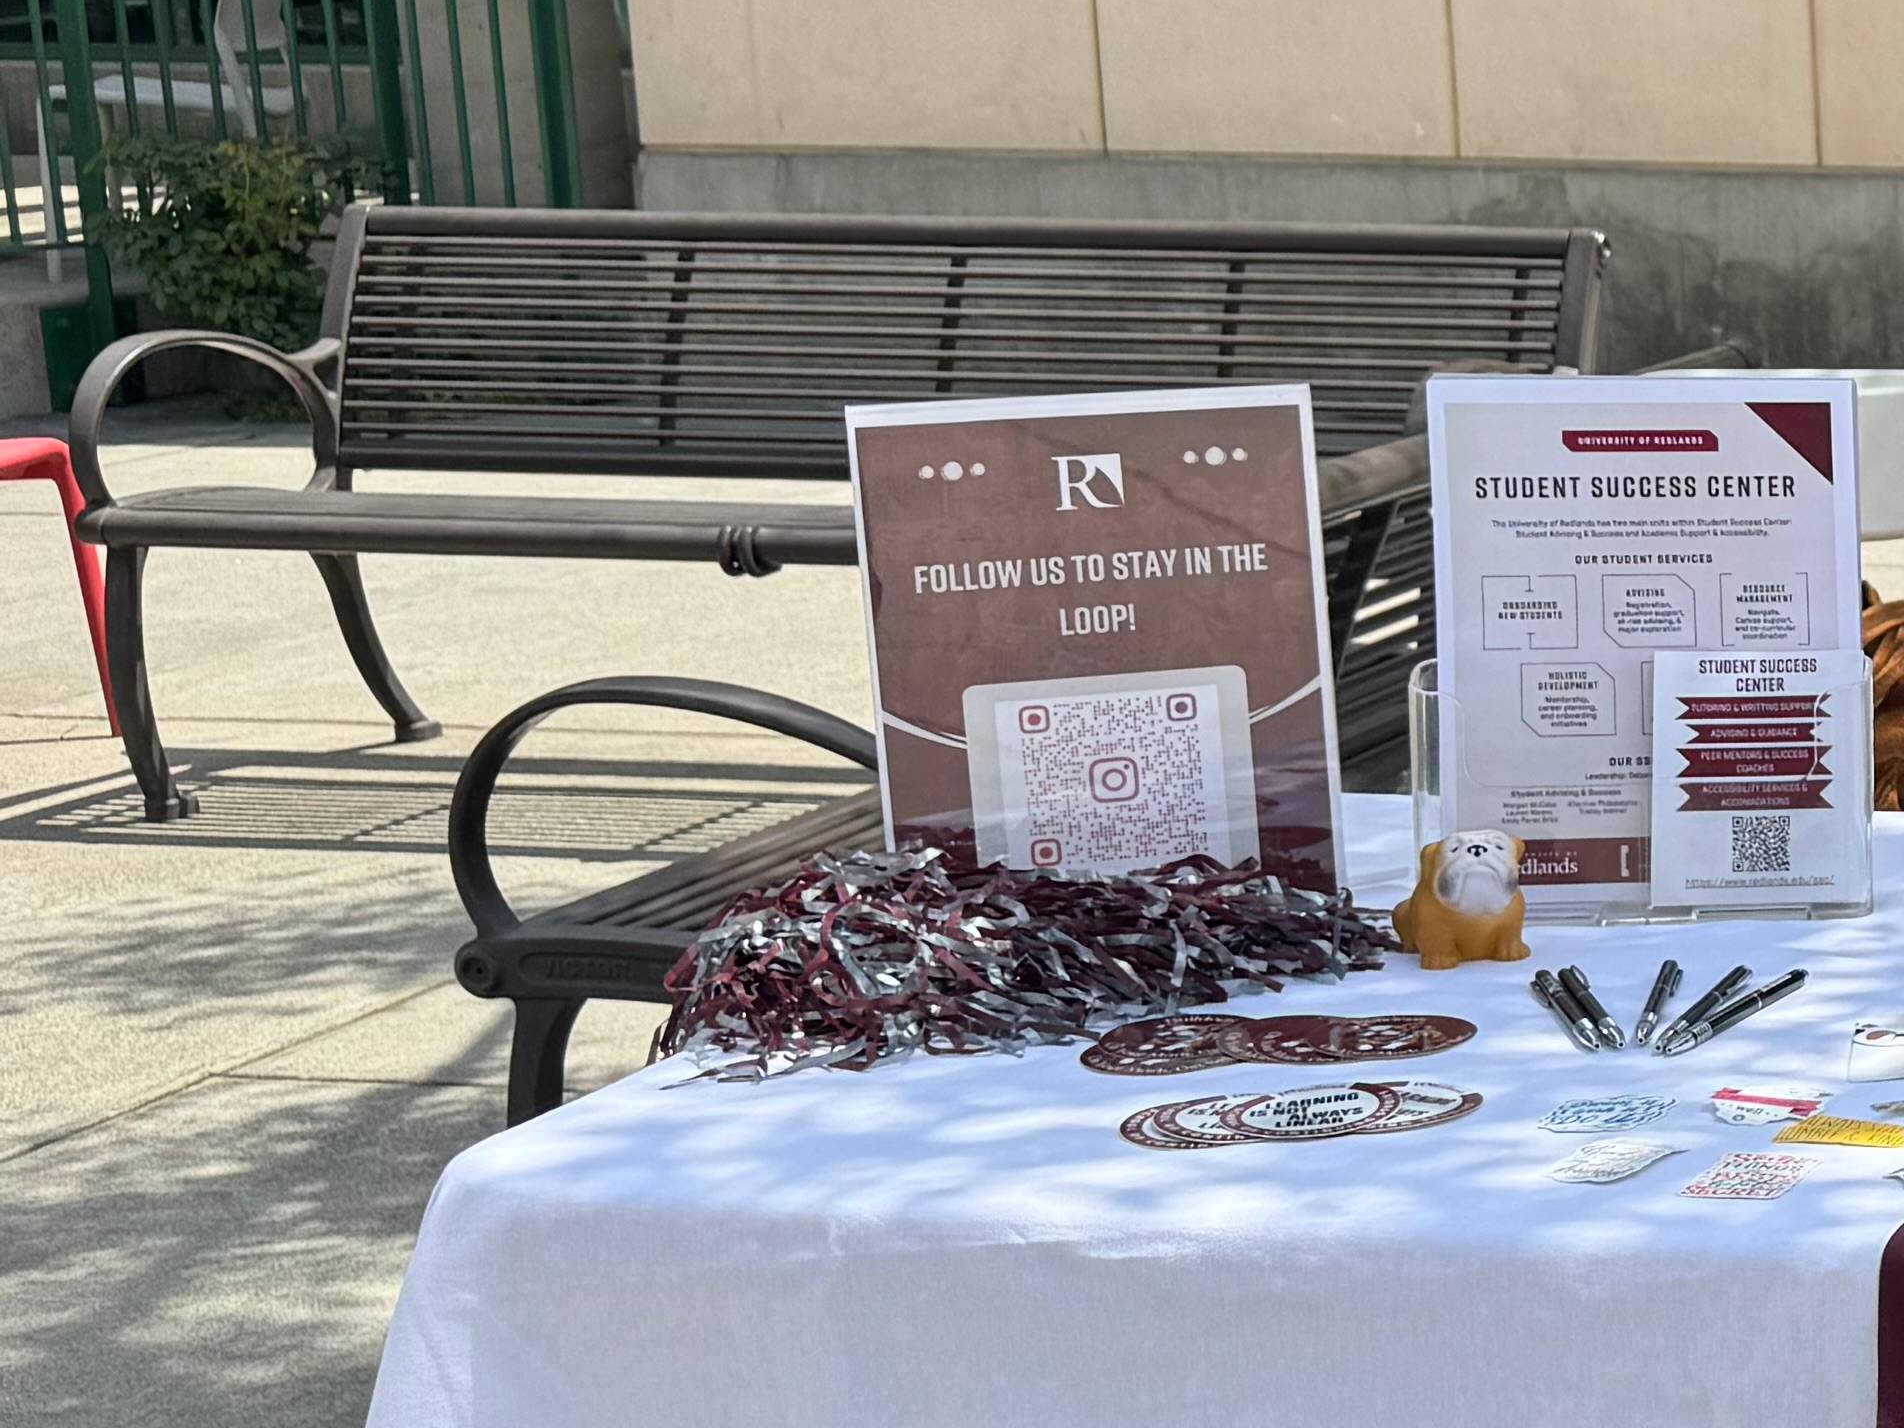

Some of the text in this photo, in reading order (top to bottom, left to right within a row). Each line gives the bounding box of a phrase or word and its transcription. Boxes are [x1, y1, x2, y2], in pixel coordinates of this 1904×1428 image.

[1578, 436, 1703, 445] UNIVERSITY OF REDLANDS
[1475, 475, 1796, 499] STUDENT SUCCESS CENTER
[1575, 554, 1713, 564] OUR STUDENT SERVICES
[914, 543, 1268, 594] FOLLOW US TO STAY IN THE
[1059, 603, 1136, 636] LOOP!
[1519, 611, 1562, 619] STUDENTS
[1699, 658, 1817, 674] STUDENT SUCCESS
[1736, 677, 1785, 692] CENTER
[1609, 757, 1633, 766] OUR
[1265, 1092, 1360, 1110] LEARNING
[1249, 1105, 1268, 1117] IS
[1273, 1116, 1344, 1129] LINEAR
